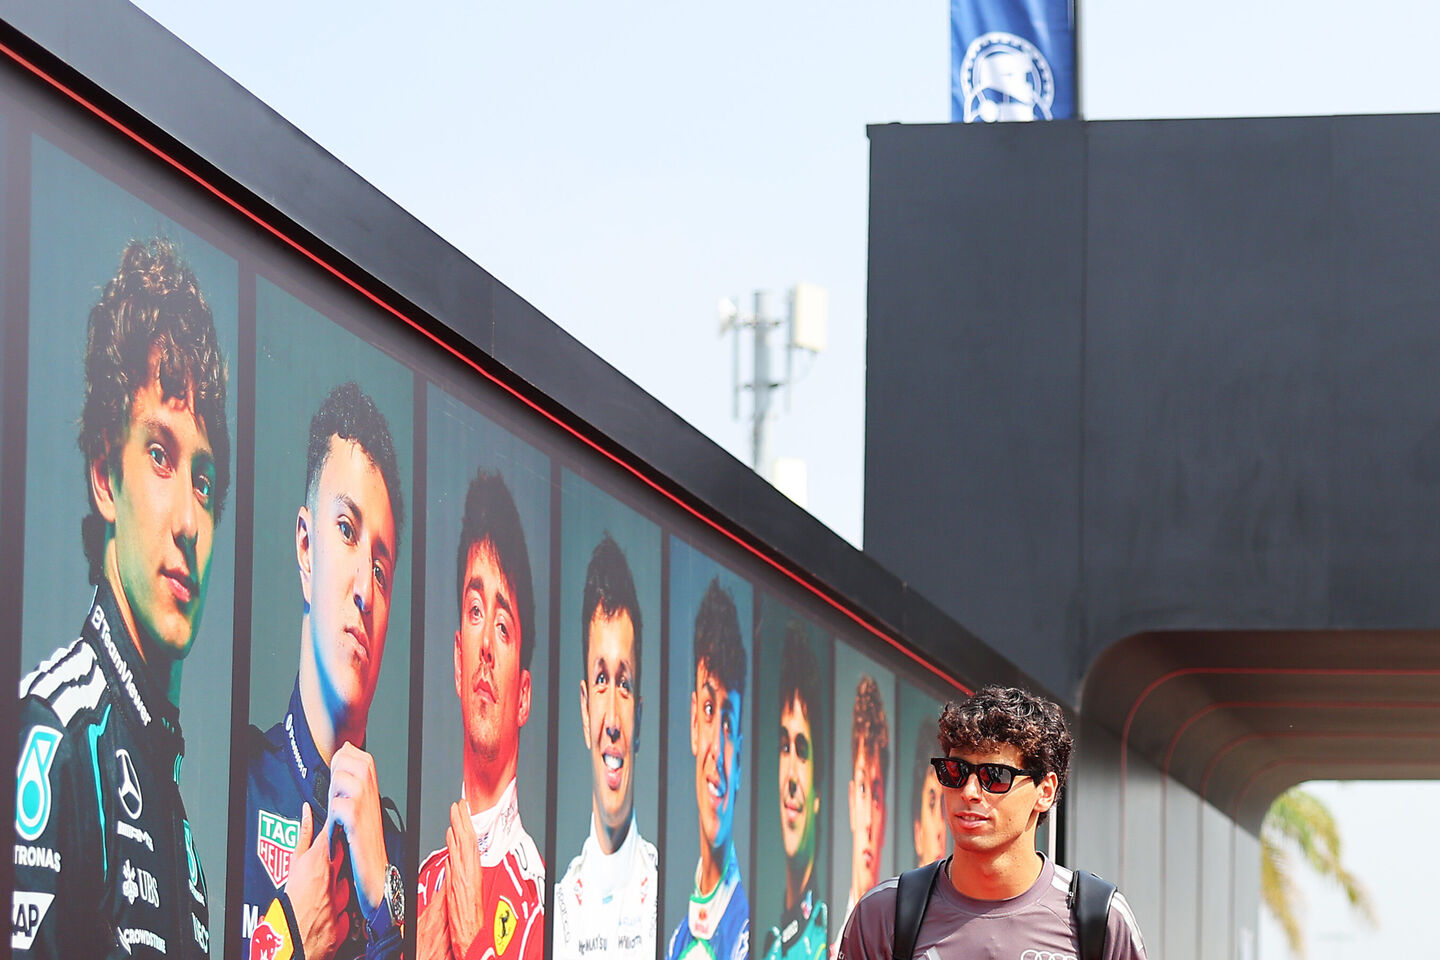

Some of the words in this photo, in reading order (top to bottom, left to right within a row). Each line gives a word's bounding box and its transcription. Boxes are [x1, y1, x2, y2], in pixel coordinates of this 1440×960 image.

[262, 816, 298, 846] TAG
[260, 841, 293, 887] HEUE
[137, 867, 160, 908] UBS
[13, 903, 40, 938] AP
